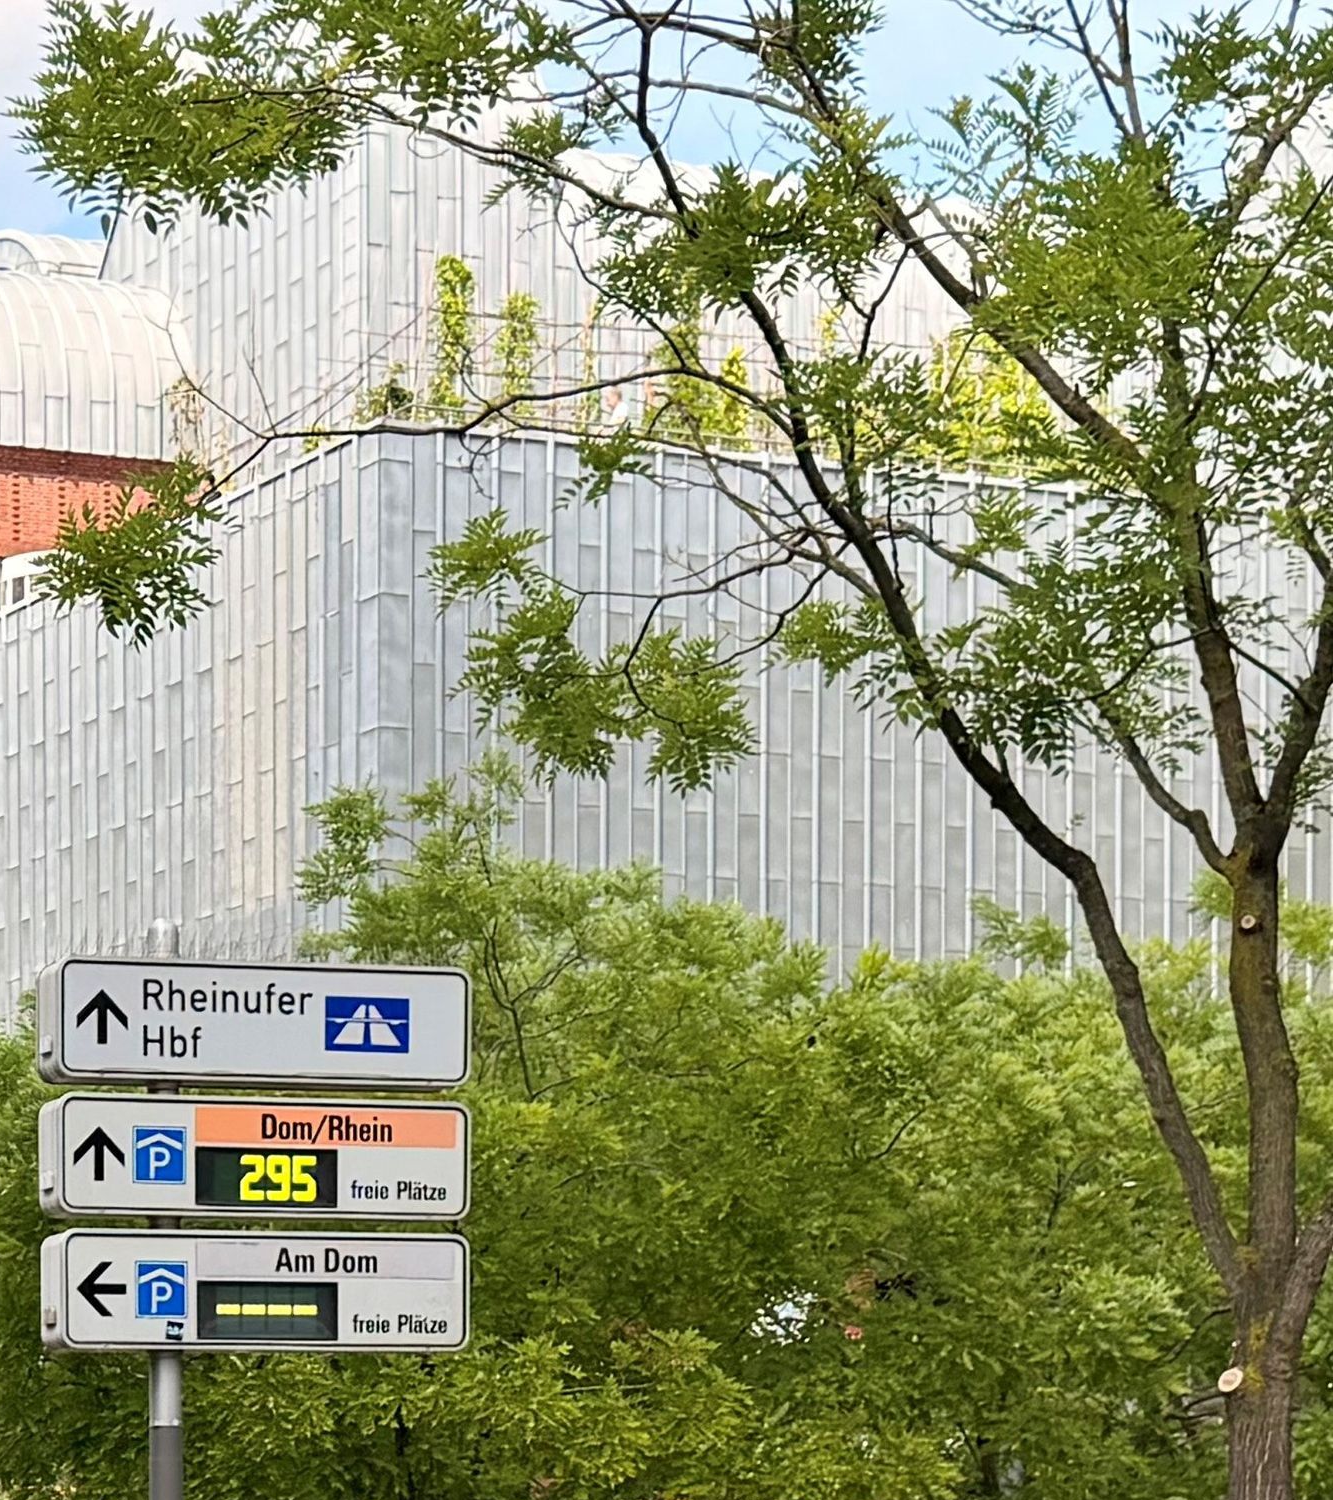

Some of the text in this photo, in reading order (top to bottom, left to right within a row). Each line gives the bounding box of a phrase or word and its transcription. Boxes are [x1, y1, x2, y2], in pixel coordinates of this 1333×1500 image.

[141, 978, 314, 1017] Rheinufer
[141, 1024, 203, 1059] Hbf
[260, 1114, 394, 1144] Dom/Rhein
[148, 1146, 172, 1179] P
[238, 1154, 318, 1203] 295
[350, 1180, 448, 1202] freie Plätze
[274, 1248, 379, 1275] Am Dom
[150, 1281, 173, 1314] P
[352, 1314, 449, 1336] freie Plätze
